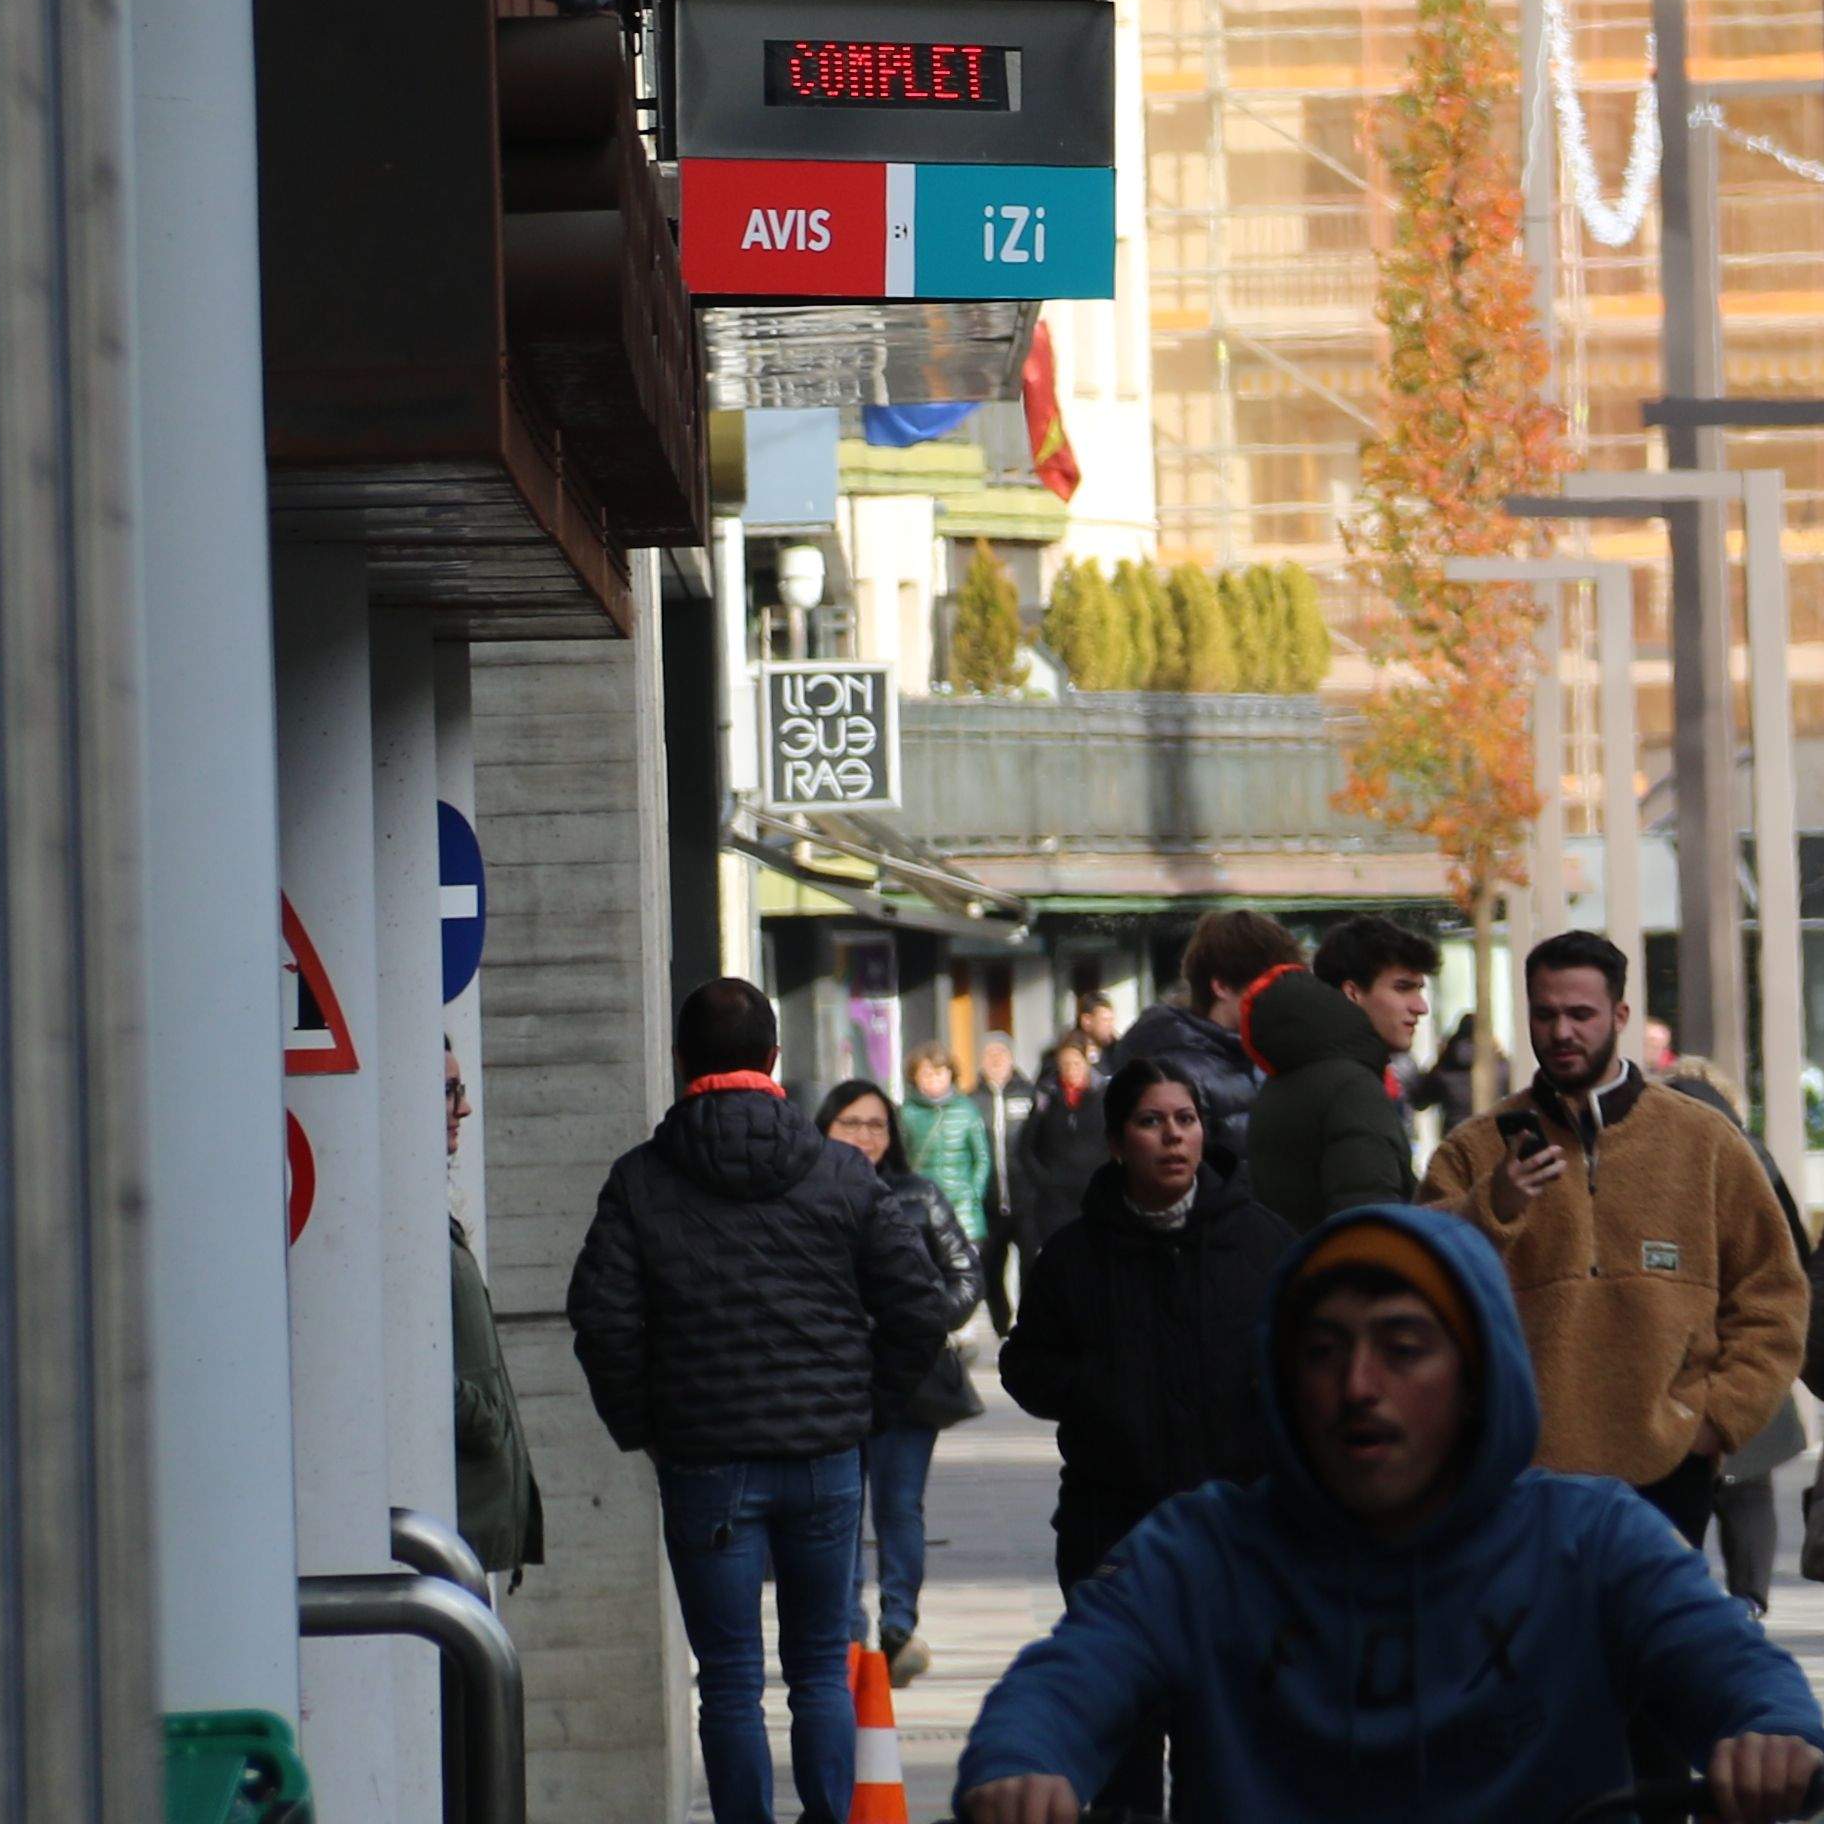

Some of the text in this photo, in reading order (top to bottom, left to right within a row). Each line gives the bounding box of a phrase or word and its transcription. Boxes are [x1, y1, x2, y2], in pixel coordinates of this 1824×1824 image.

[789, 44, 983, 99] COMPLET
[741, 204, 1046, 264] AVIS iZi
